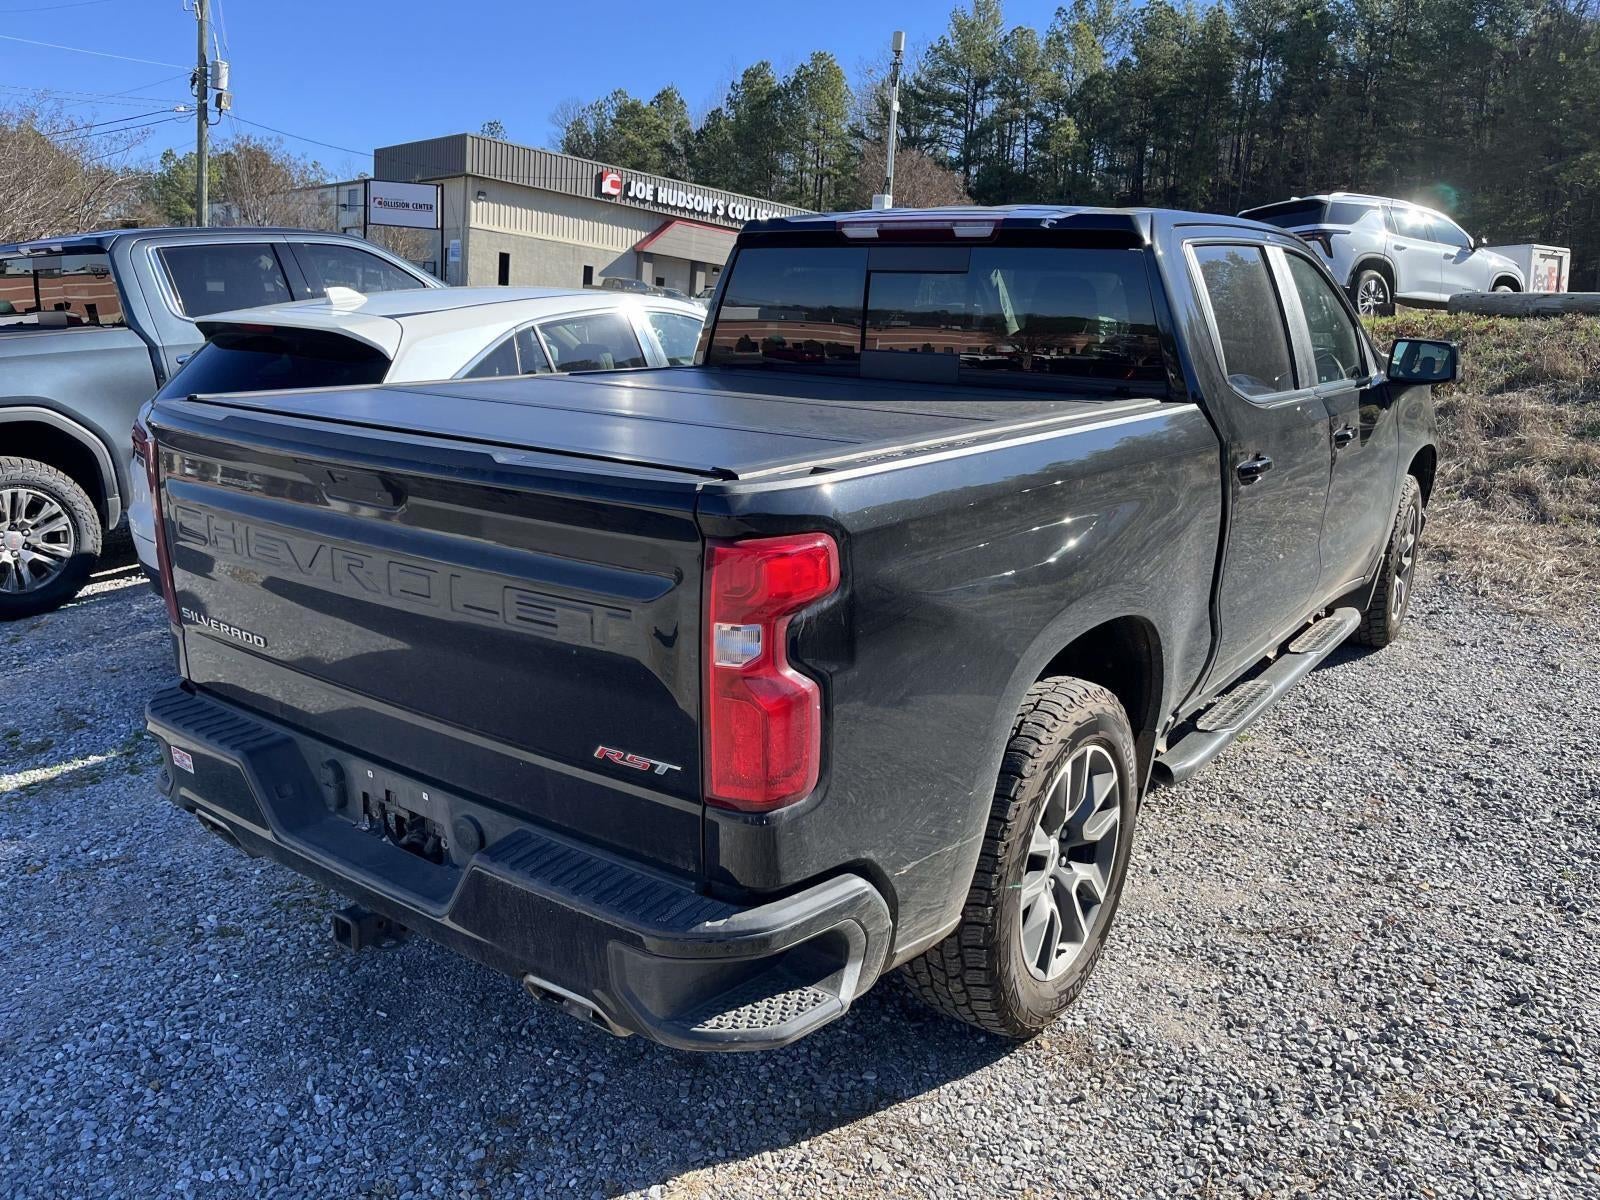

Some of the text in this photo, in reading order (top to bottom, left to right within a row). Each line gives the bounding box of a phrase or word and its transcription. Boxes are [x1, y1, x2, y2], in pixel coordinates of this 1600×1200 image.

[412, 202, 433, 211] CENTER
[628, 180, 654, 200] JOE
[657, 187, 725, 216] HUDSON'S
[174, 503, 632, 645] CHEVROLET
[181, 607, 266, 648] SILVERADO
[594, 745, 682, 775] RST
